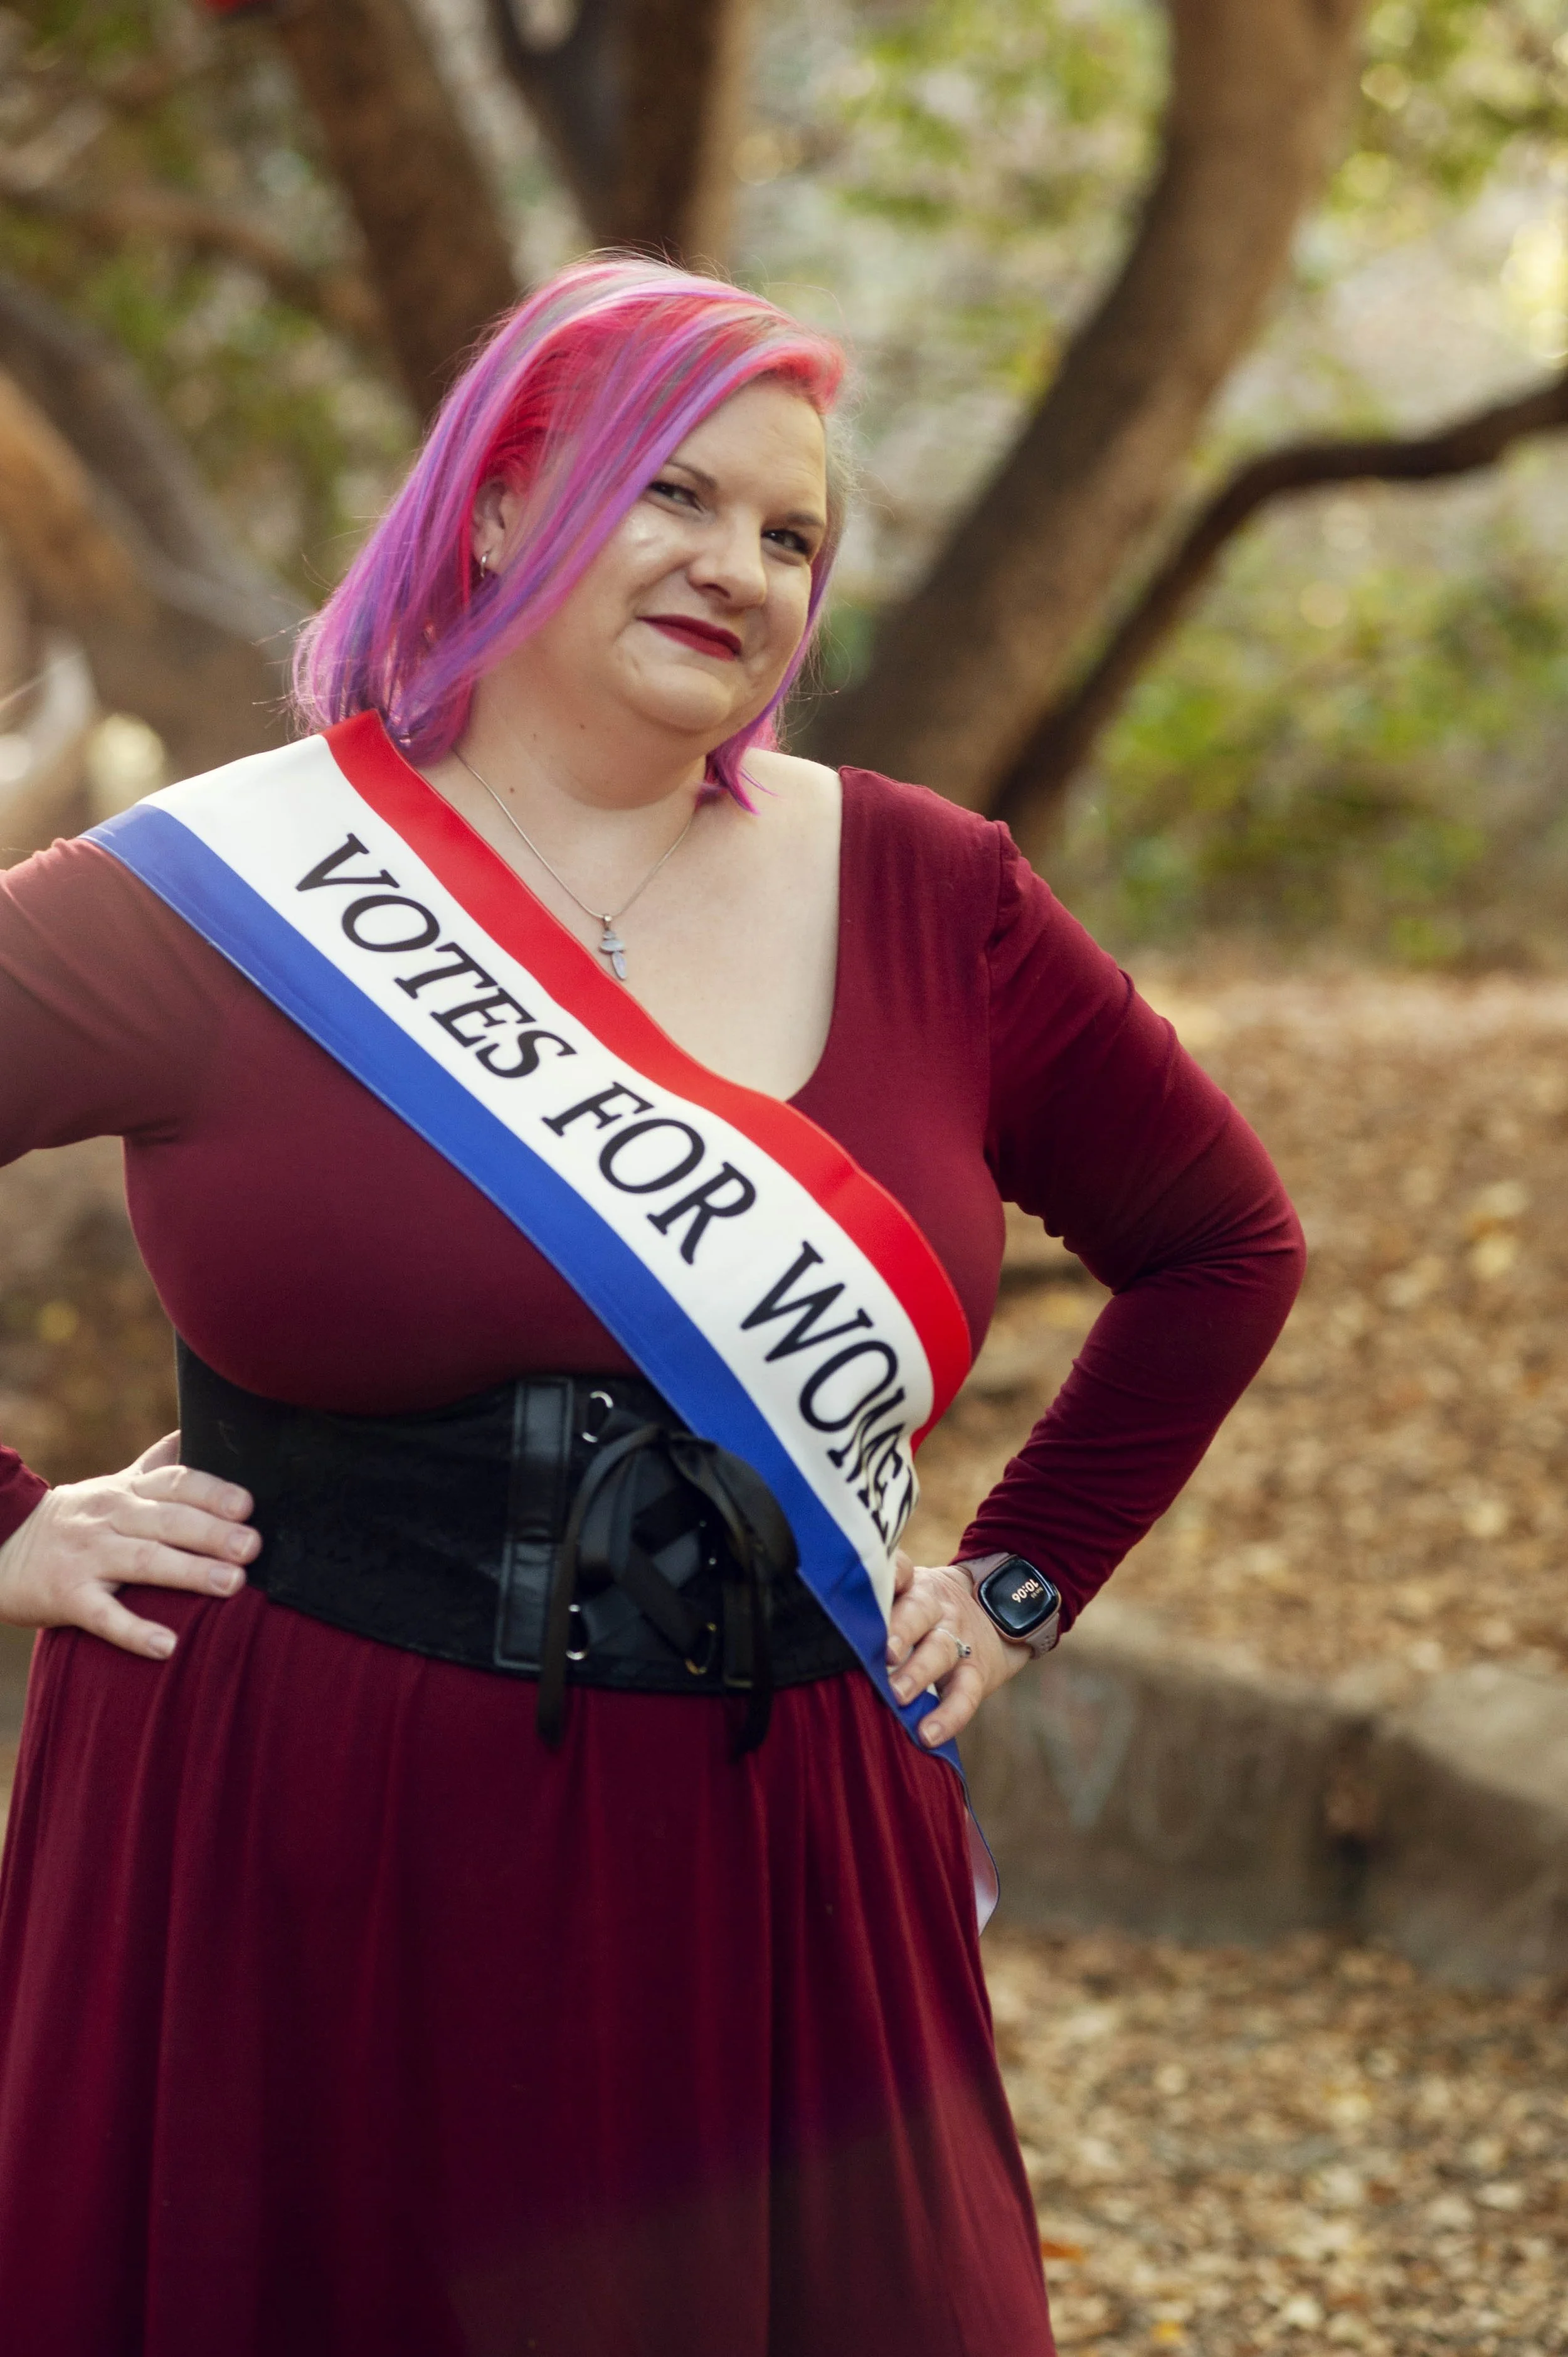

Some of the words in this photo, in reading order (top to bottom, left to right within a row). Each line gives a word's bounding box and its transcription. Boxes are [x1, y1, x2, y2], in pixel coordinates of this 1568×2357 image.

[295, 833, 578, 1079] VOTES
[541, 1081, 757, 1265] FOR
[1011, 1578, 1039, 1603] 10:06
